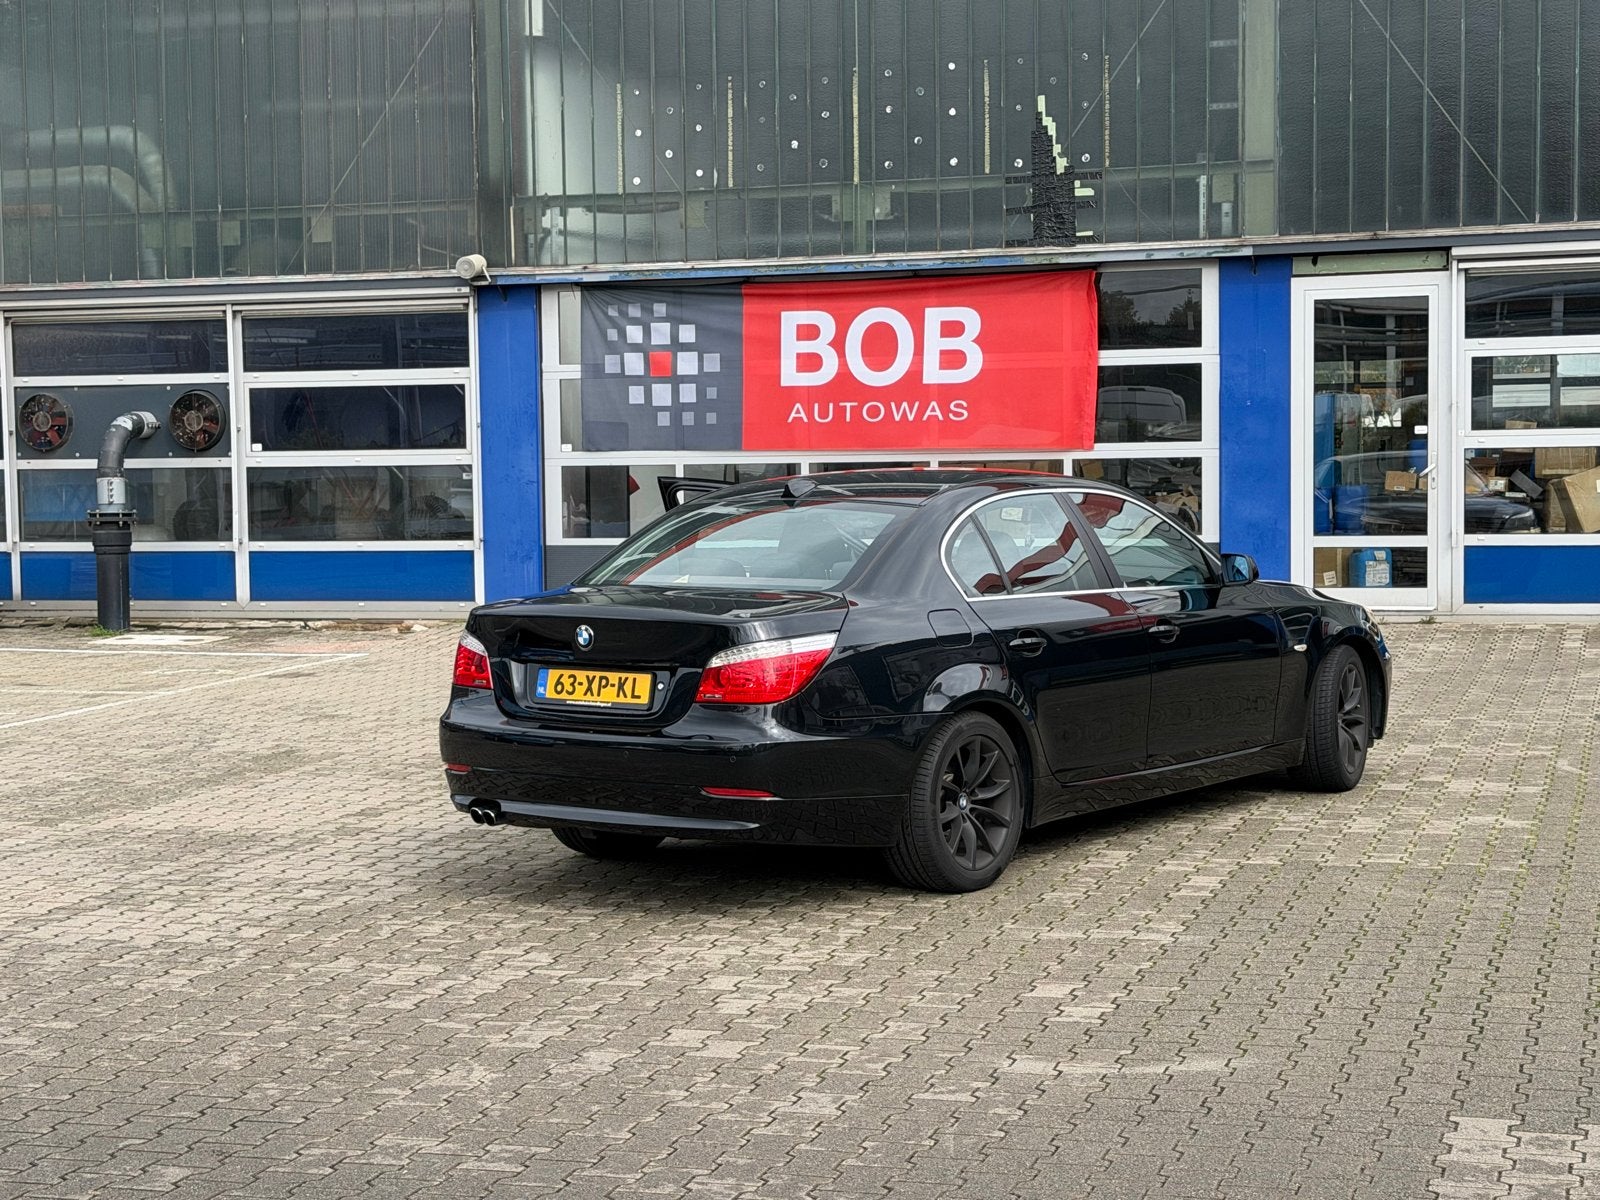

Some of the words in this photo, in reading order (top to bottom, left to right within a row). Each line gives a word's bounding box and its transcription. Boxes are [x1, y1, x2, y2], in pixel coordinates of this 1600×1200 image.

[780, 306, 984, 388] BOB
[787, 399, 969, 423] AUTOWAS
[553, 673, 642, 699] 63-XP-KL
